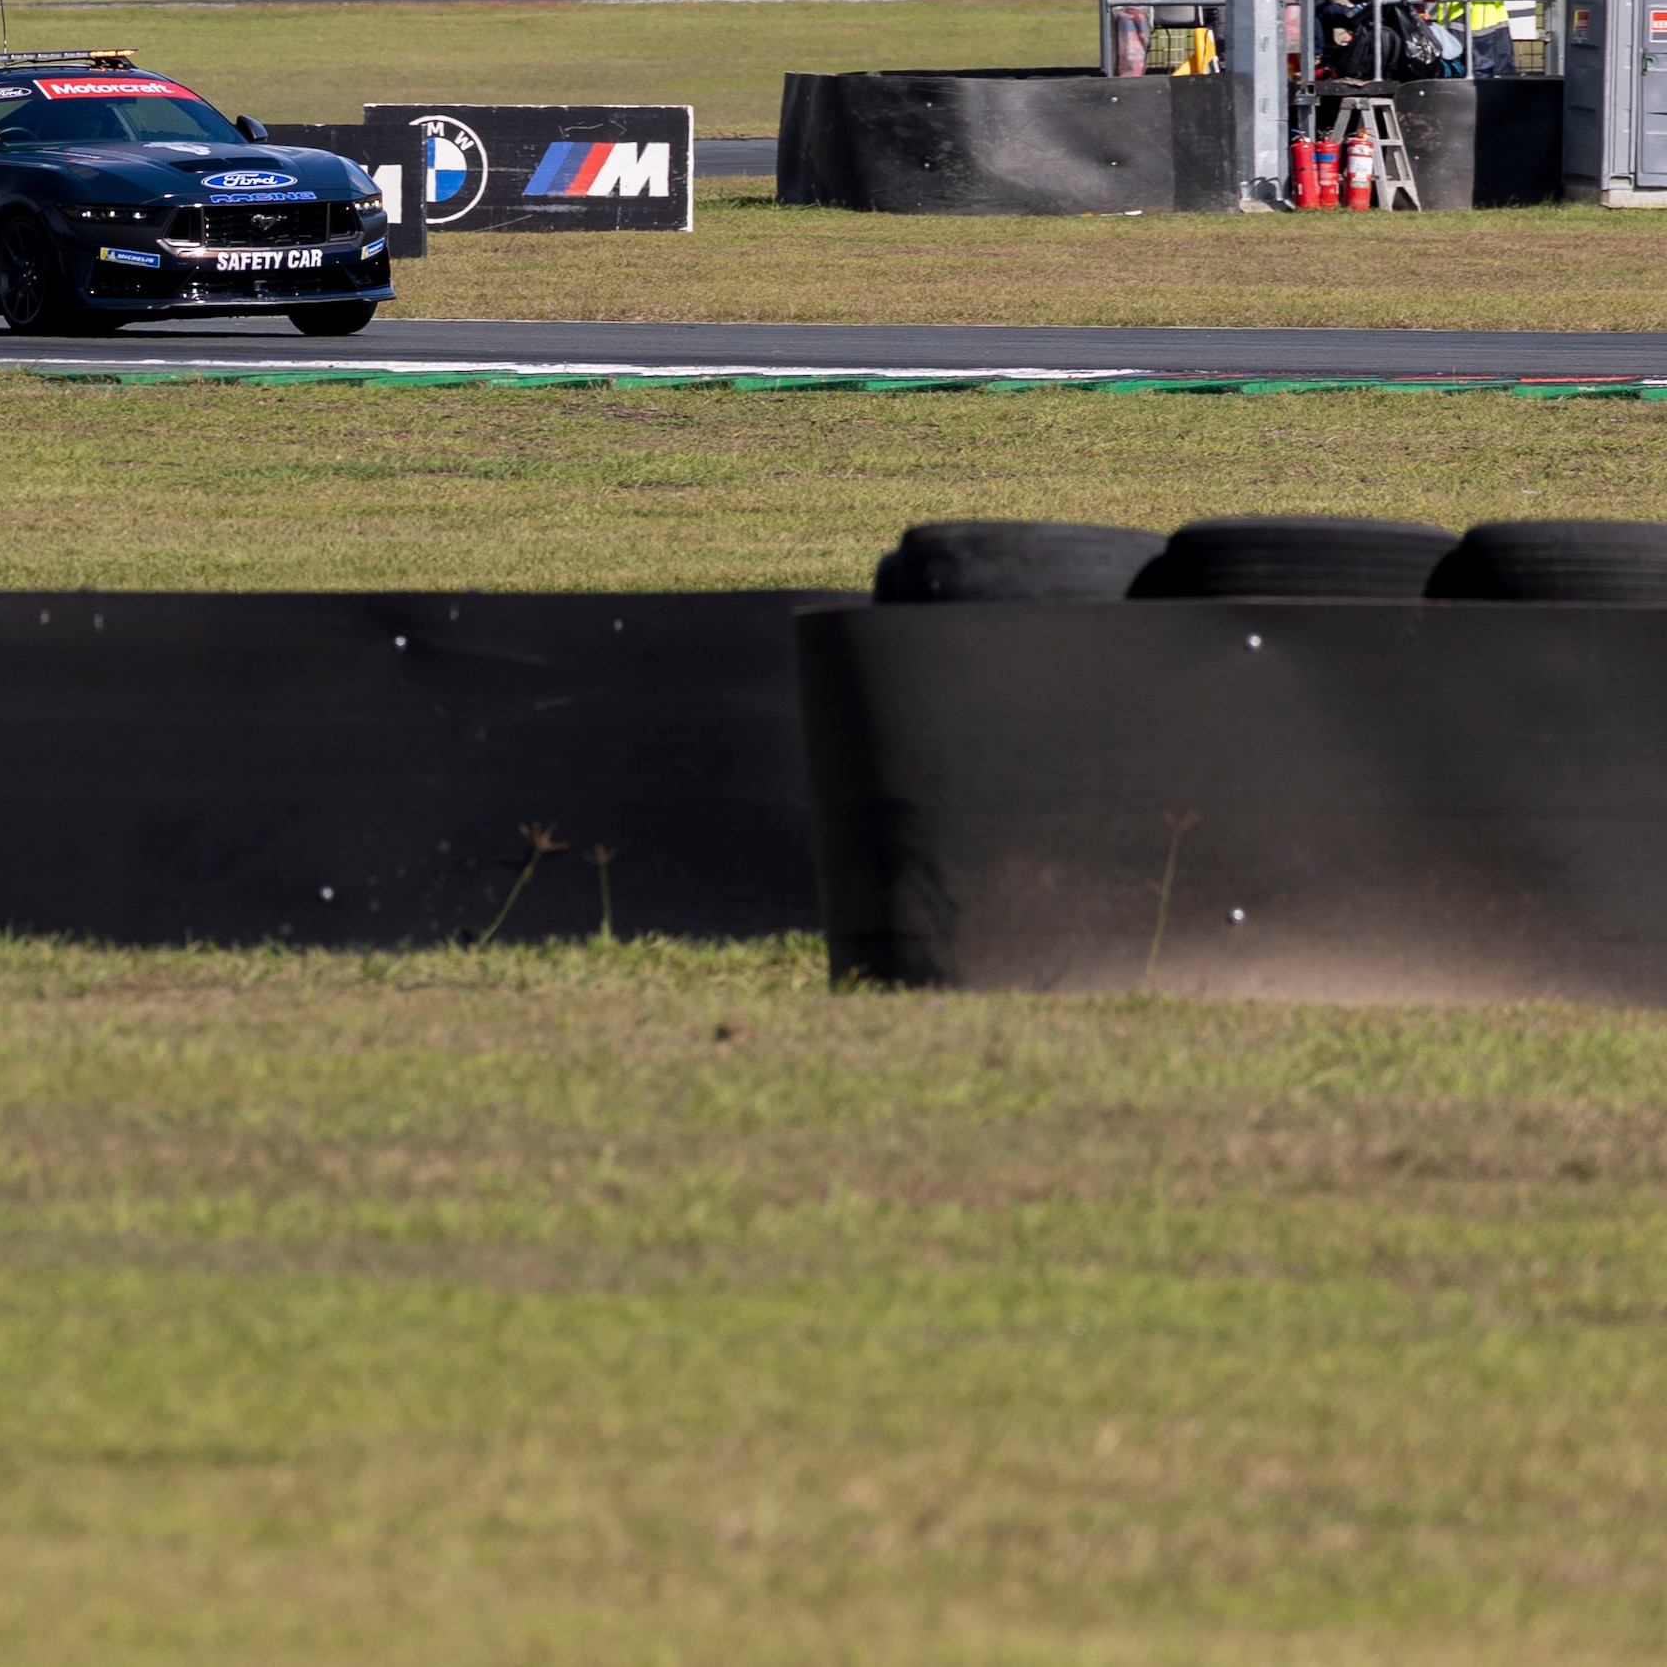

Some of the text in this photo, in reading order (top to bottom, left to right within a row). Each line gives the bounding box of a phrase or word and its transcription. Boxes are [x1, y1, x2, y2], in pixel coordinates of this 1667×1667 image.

[50, 81, 175, 95] Motorcraft
[426, 121, 474, 152] MW
[222, 173, 279, 187] Ford
[209, 191, 318, 204] RACING
[116, 252, 155, 265] MICHELIN
[216, 249, 324, 272] SAFETY CAR
